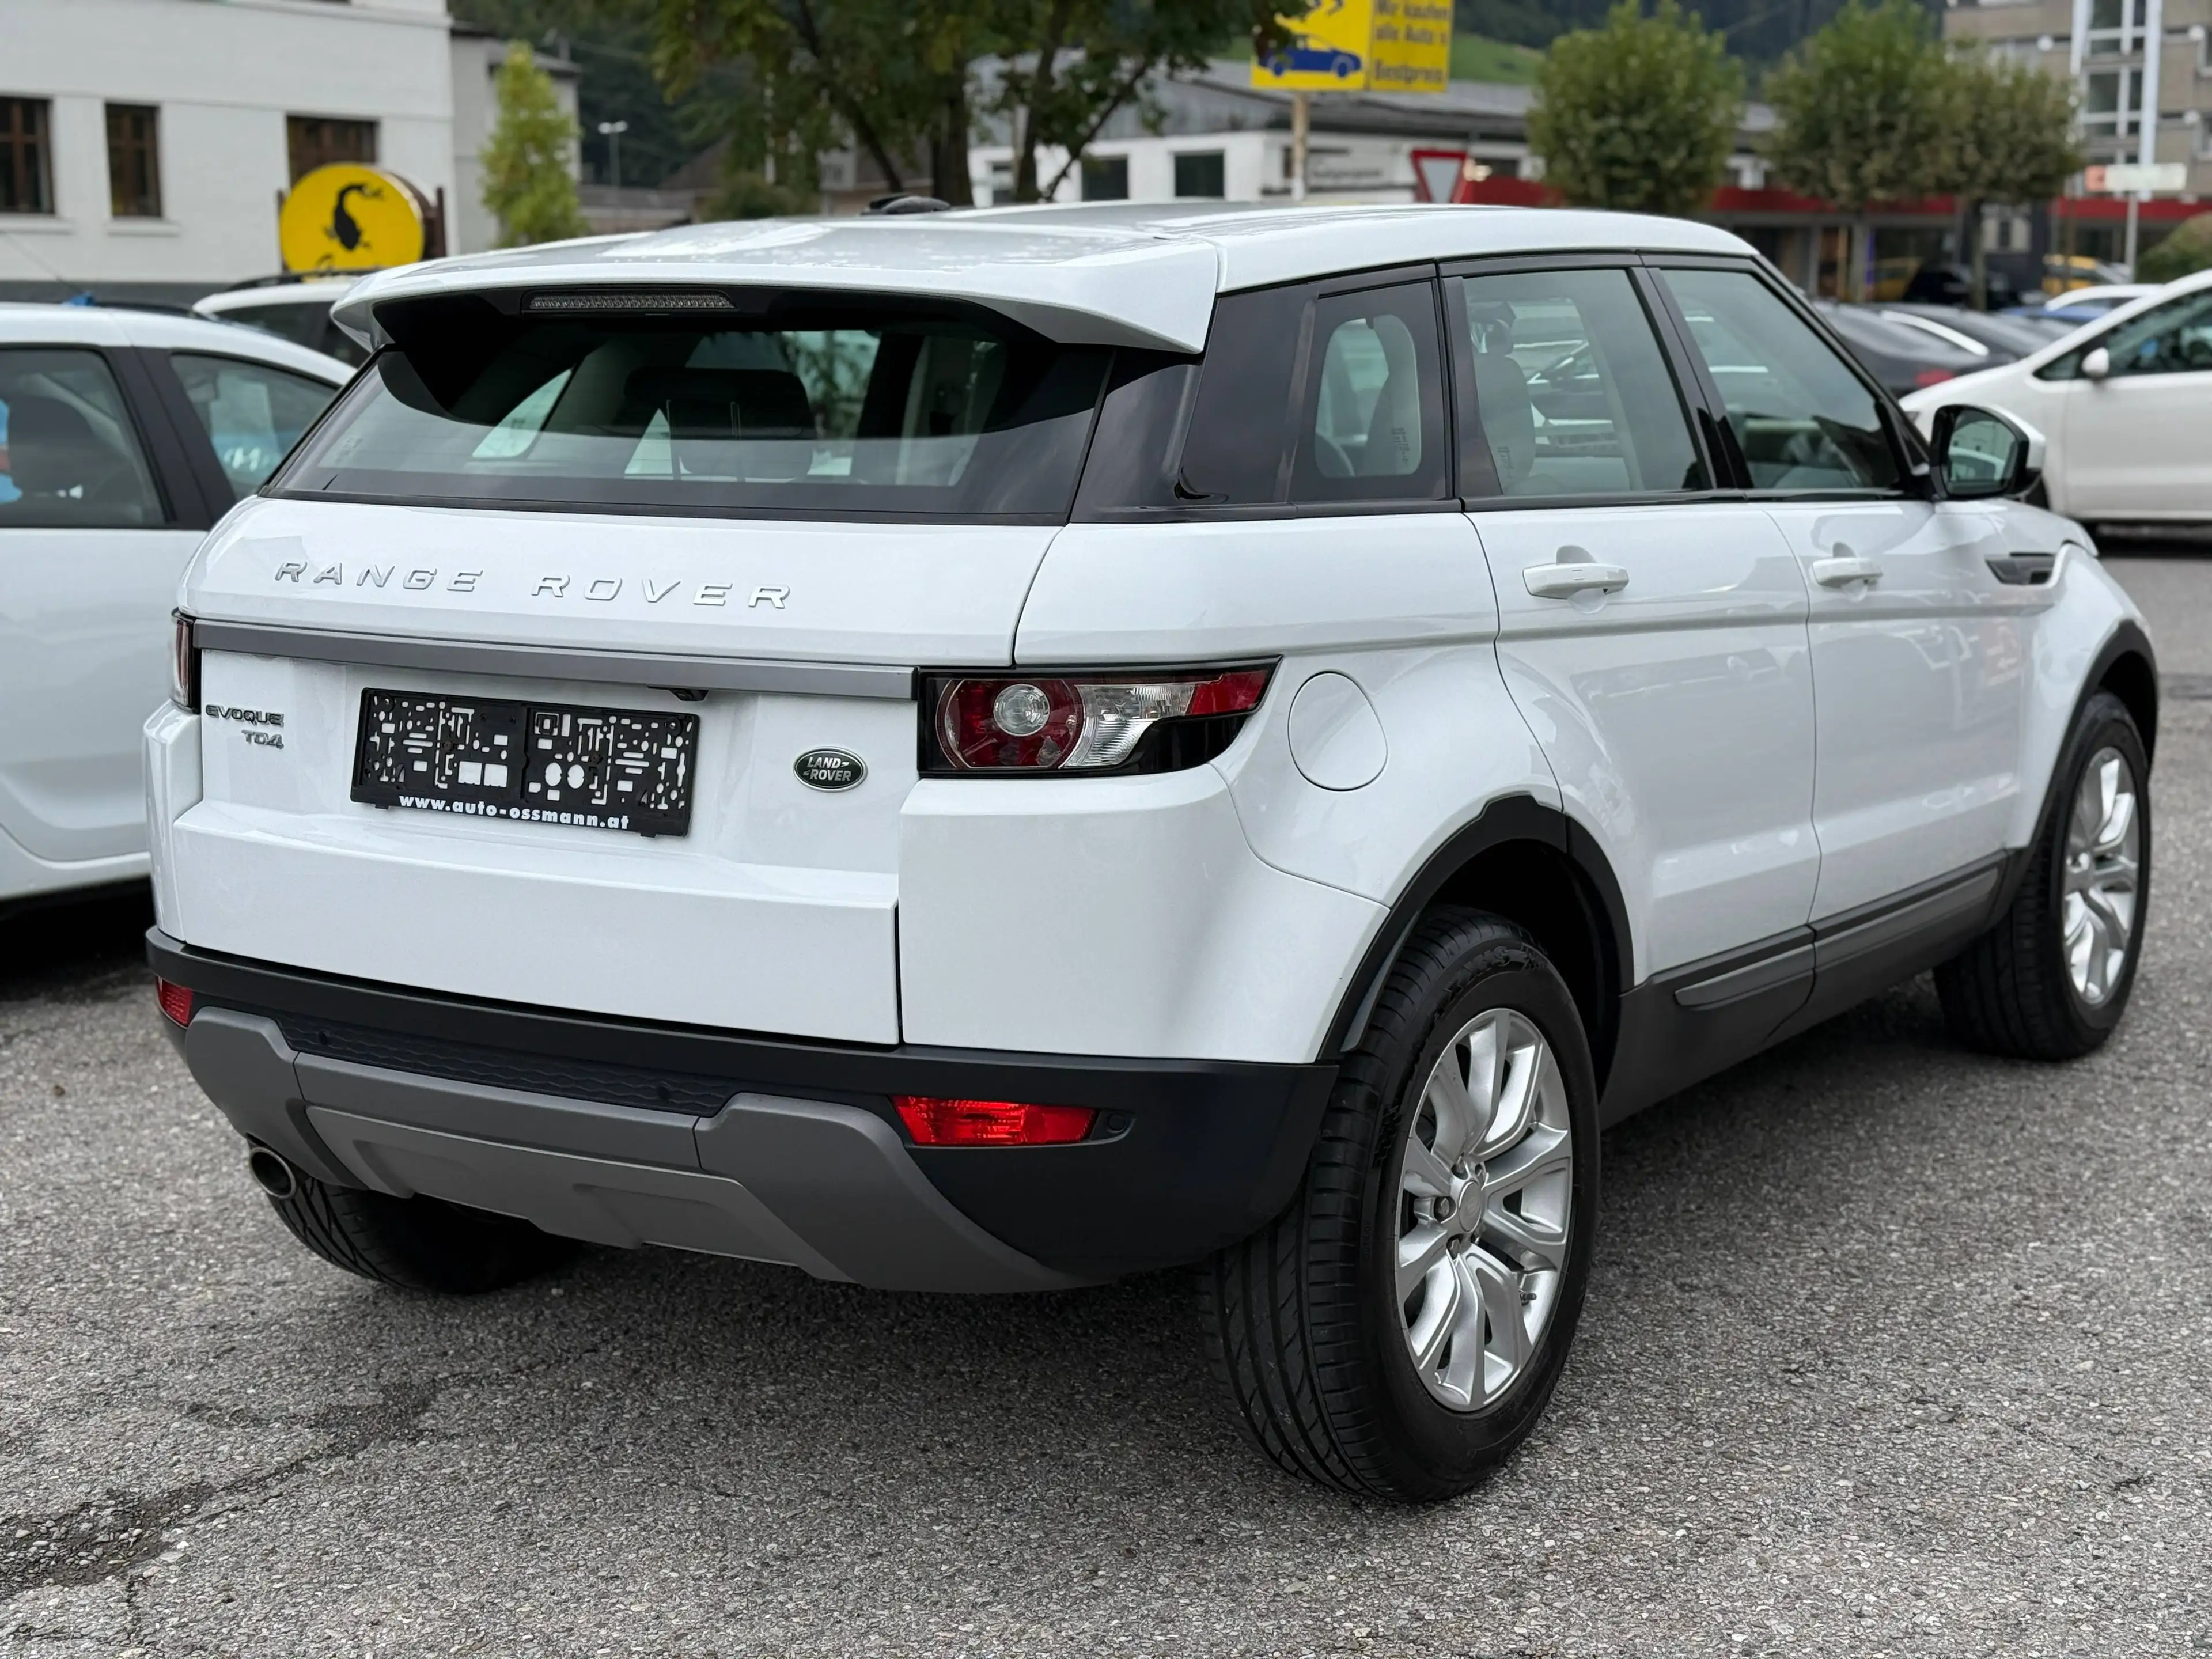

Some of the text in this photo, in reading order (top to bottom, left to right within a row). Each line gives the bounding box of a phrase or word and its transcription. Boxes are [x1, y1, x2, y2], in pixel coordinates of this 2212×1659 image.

[275, 561, 791, 609] RANGE ROVER
[206, 704, 285, 727] EVOQUE
[241, 729, 285, 749] TD4
[809, 769, 852, 781] ROVER
[399, 795, 630, 830] www.auto-ossmann.at
